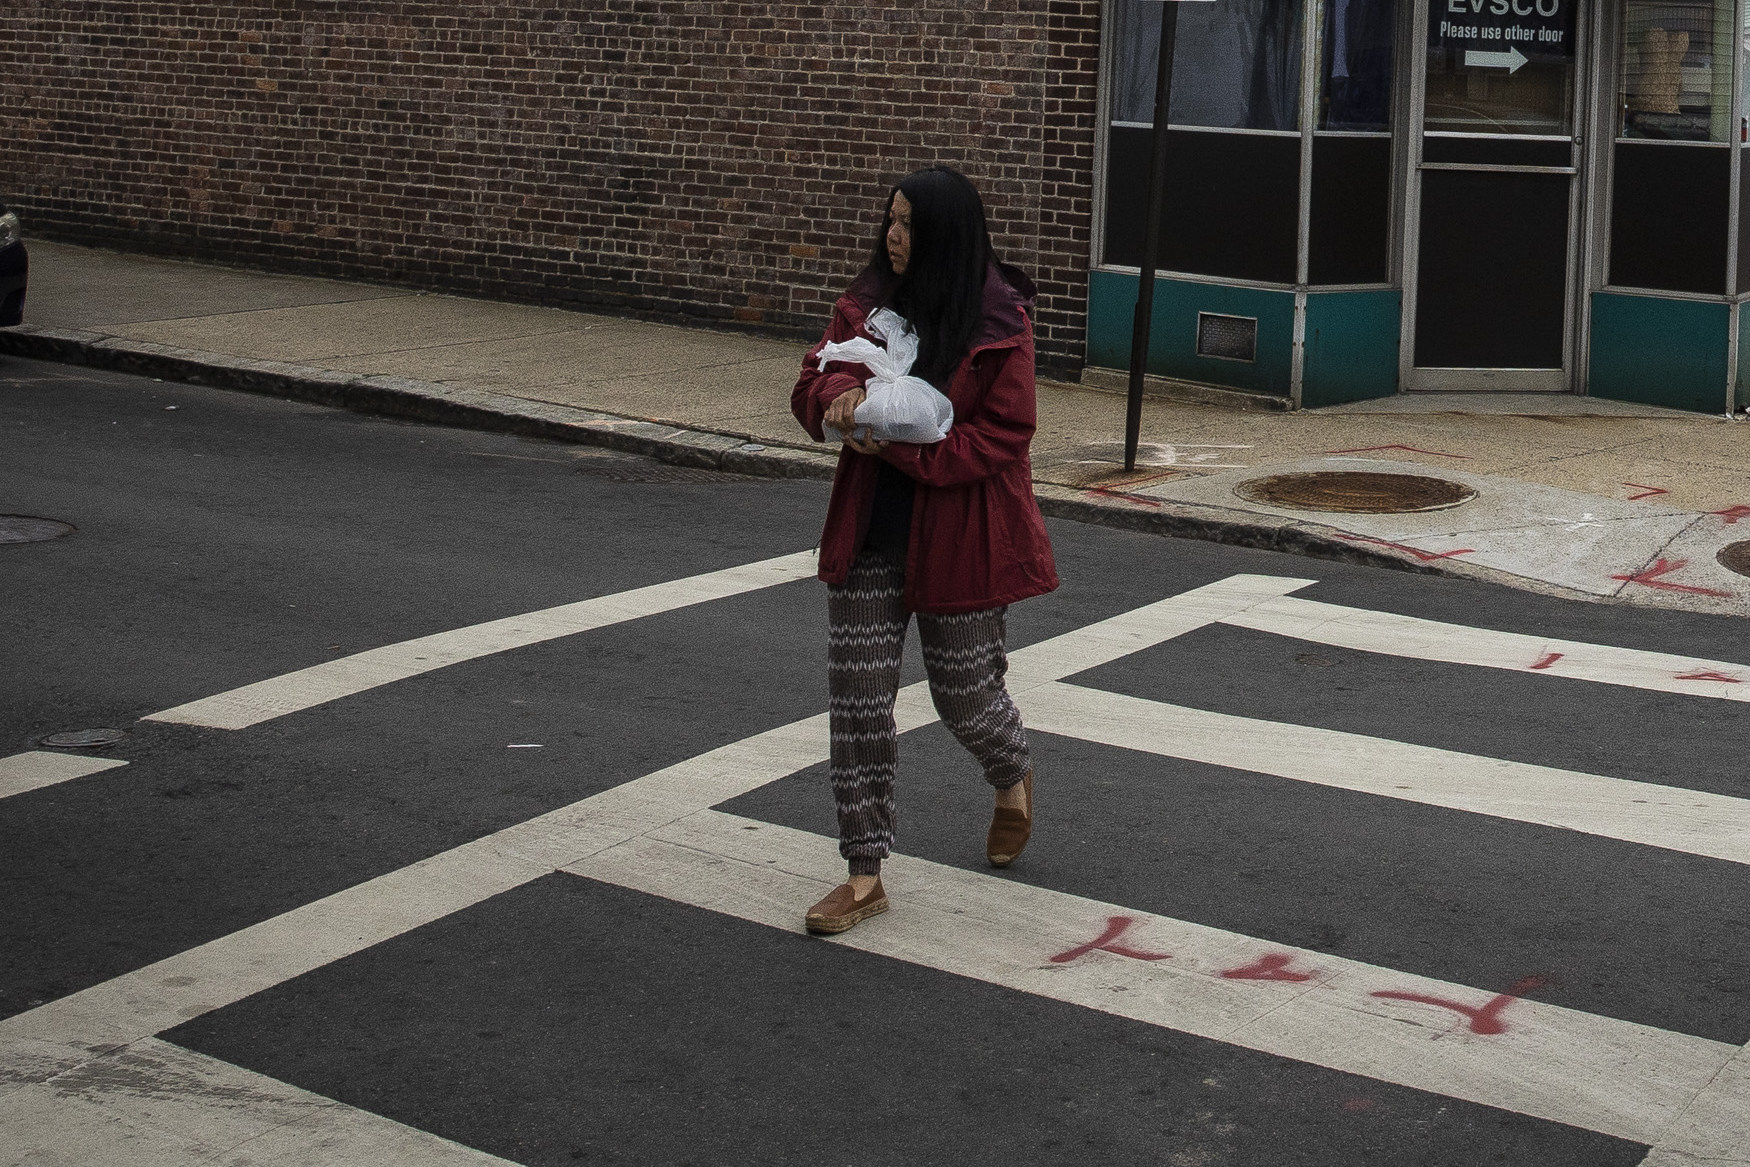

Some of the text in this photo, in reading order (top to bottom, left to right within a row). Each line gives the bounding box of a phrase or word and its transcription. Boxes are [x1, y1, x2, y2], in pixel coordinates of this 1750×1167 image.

[1440, 21, 1564, 42] Please use other door
